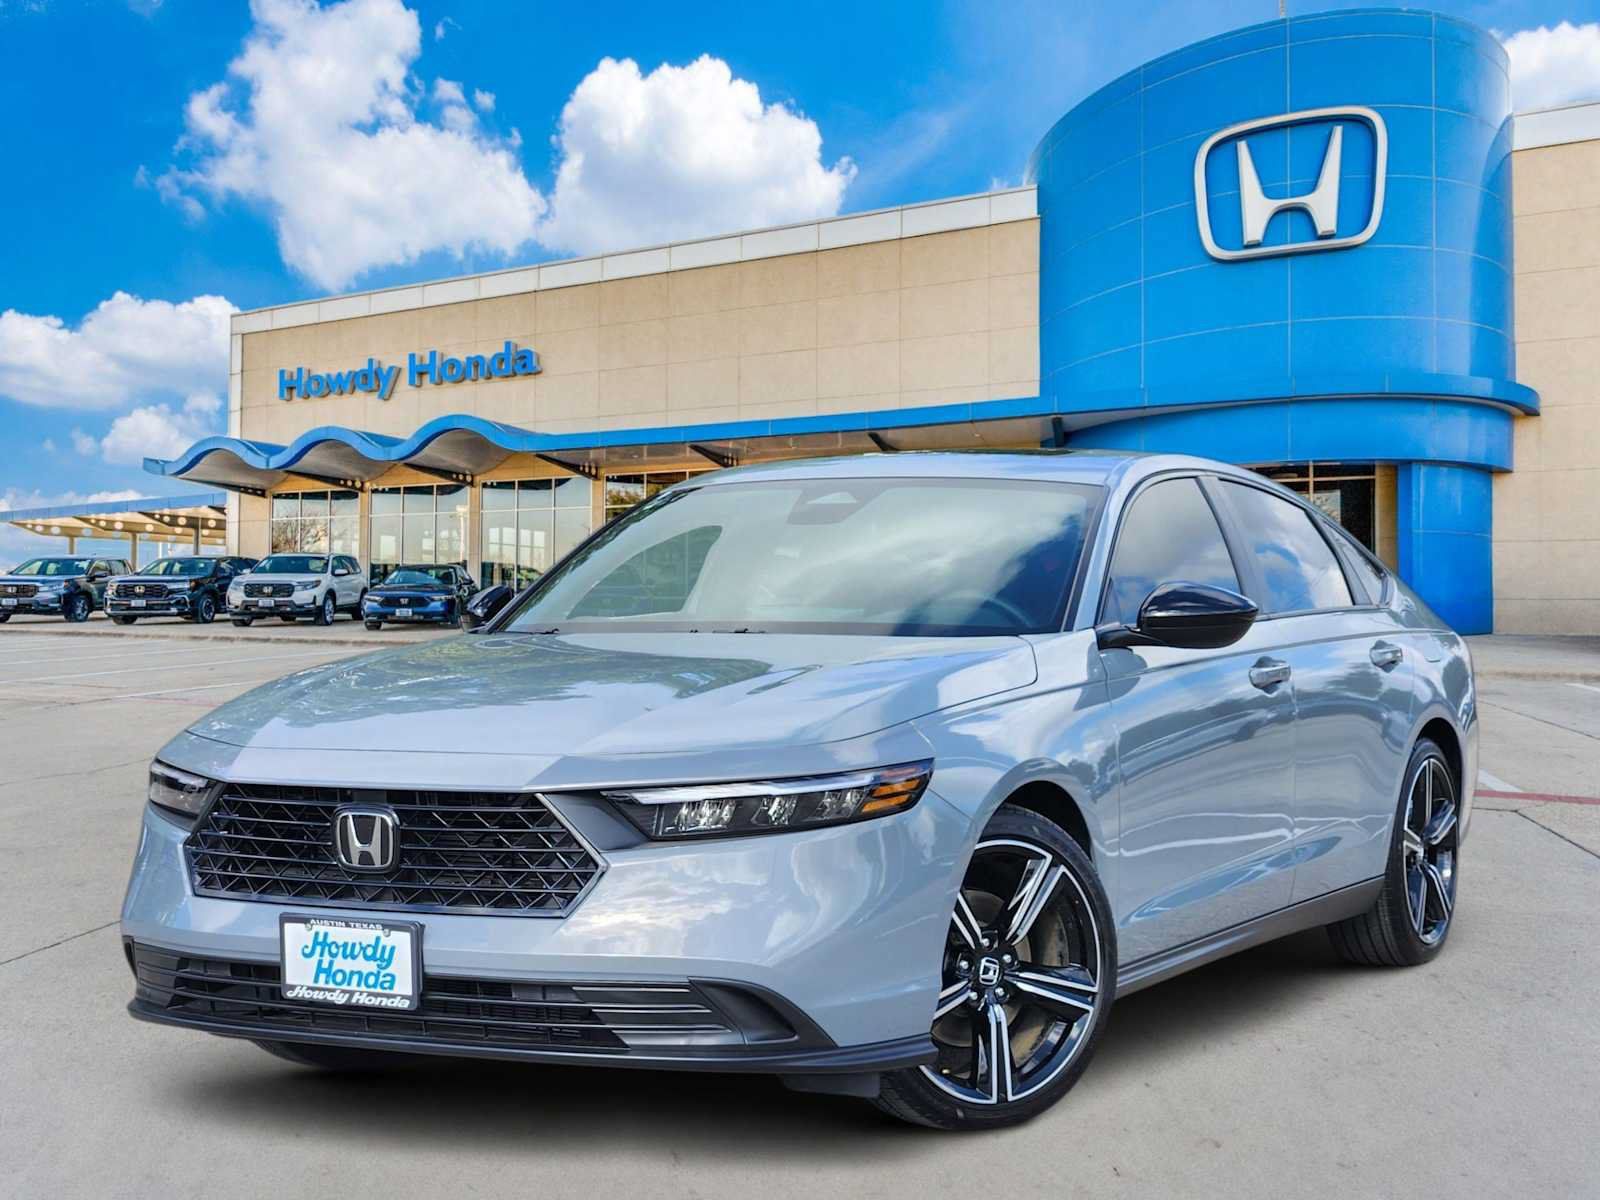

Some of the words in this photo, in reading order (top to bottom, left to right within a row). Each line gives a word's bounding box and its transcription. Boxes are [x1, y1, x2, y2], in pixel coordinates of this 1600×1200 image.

[277, 357, 400, 401] Howdy
[407, 340, 542, 388] Honda
[310, 918, 346, 929] AUSTIN
[349, 921, 383, 931] TEXAS
[301, 931, 396, 970] Howdy
[313, 959, 396, 991] Honda
[286, 985, 349, 1004] Howdy
[351, 991, 410, 1008] Honda
